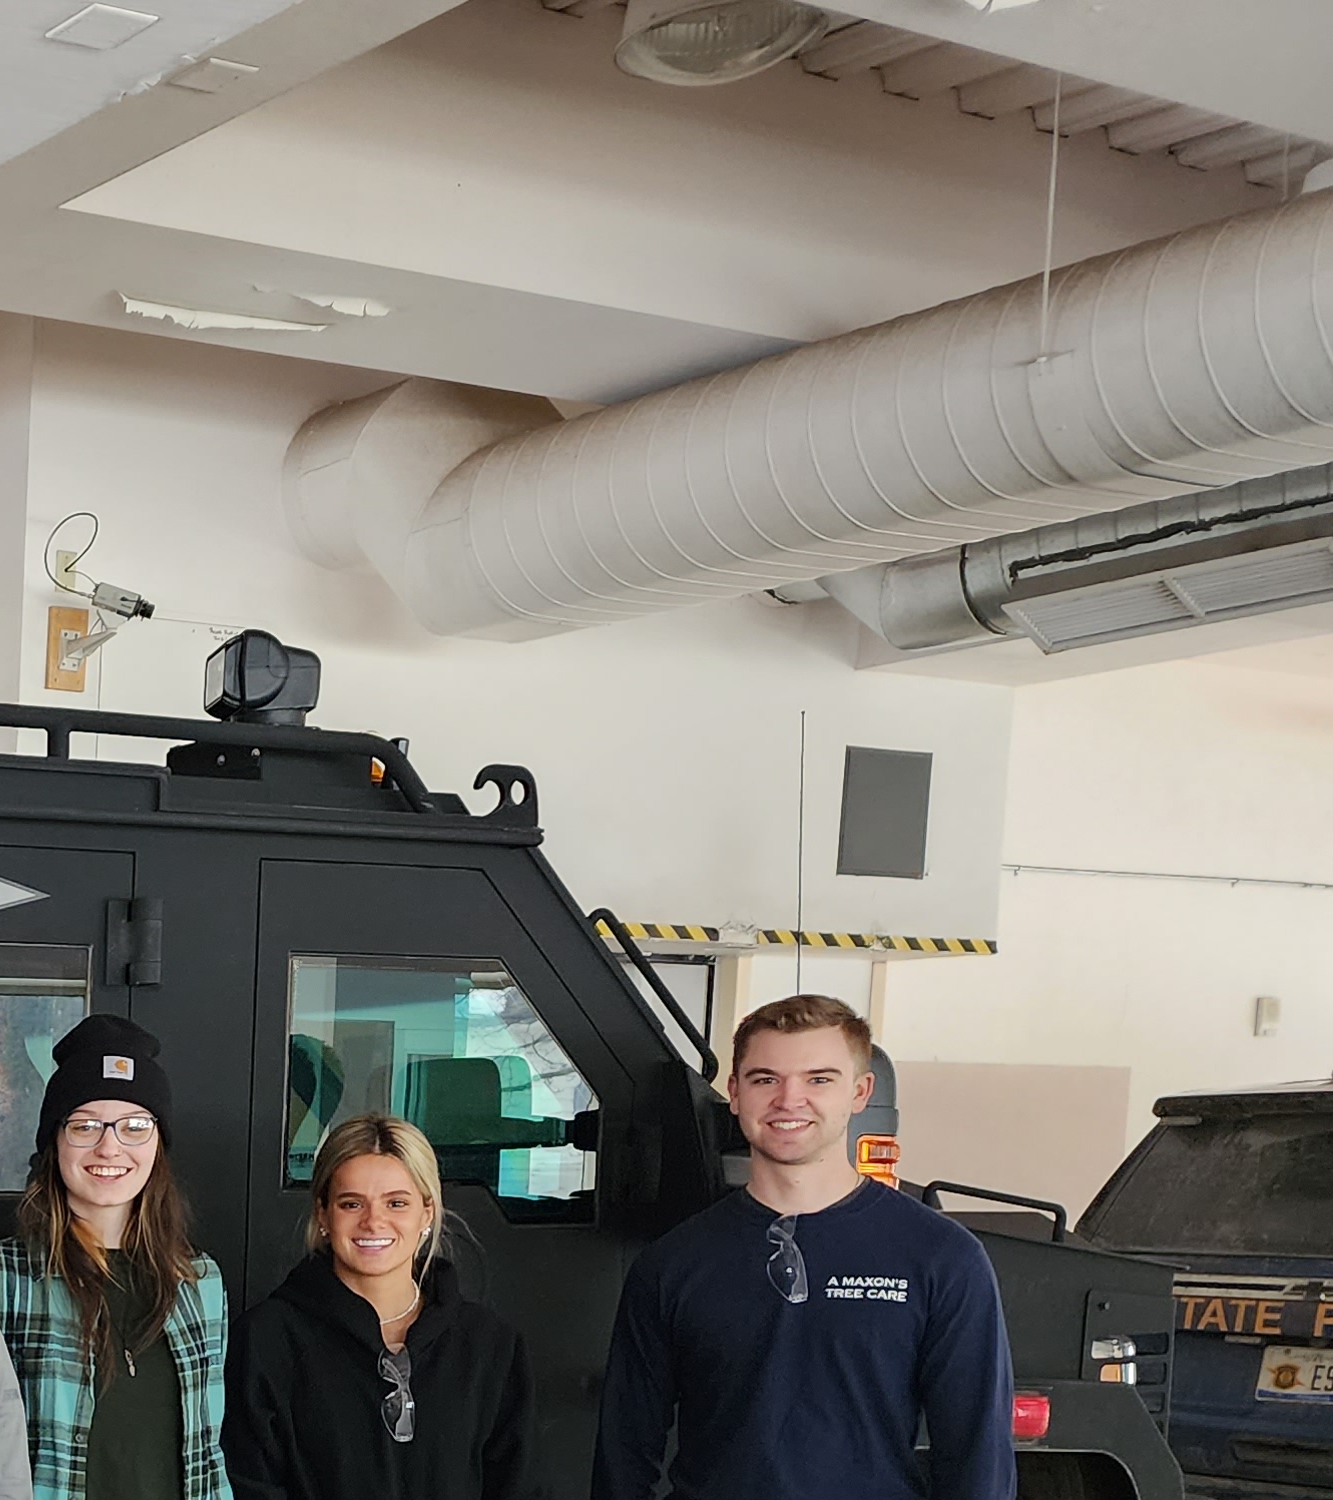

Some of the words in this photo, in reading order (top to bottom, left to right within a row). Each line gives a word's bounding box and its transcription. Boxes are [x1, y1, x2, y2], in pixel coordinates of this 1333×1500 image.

[827, 1275, 840, 1287] A
[841, 1275, 909, 1290] MAXON'S
[824, 1287, 865, 1299] TREE
[866, 1288, 909, 1303] CARE
[1180, 1296, 1286, 1335] TATE
